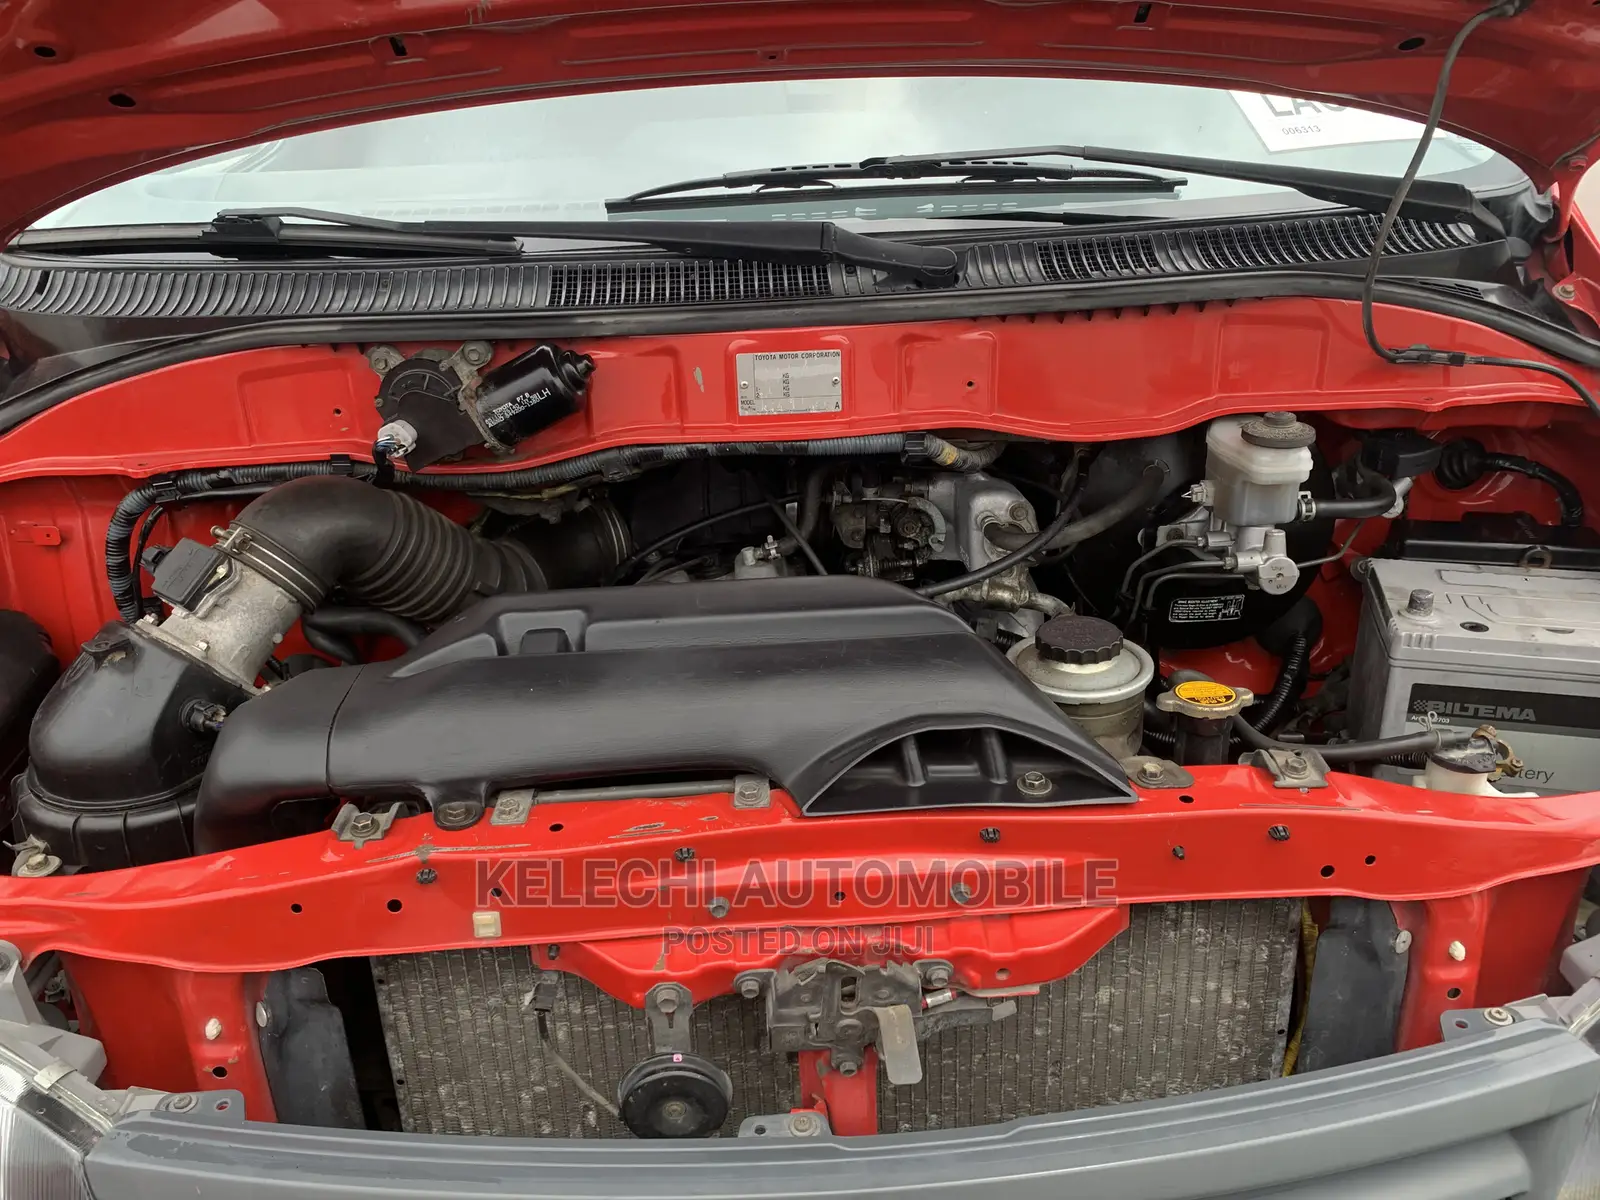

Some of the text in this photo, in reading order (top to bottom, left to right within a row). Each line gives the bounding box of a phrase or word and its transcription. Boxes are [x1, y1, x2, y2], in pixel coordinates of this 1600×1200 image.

[1261, 94, 1347, 117] LA
[1281, 124, 1322, 136] 006313
[800, 351, 841, 359] CORPORATION
[536, 387, 552, 400] LH
[493, 402, 513, 414] TOYOTA
[1426, 700, 1537, 722] BILTEMA
